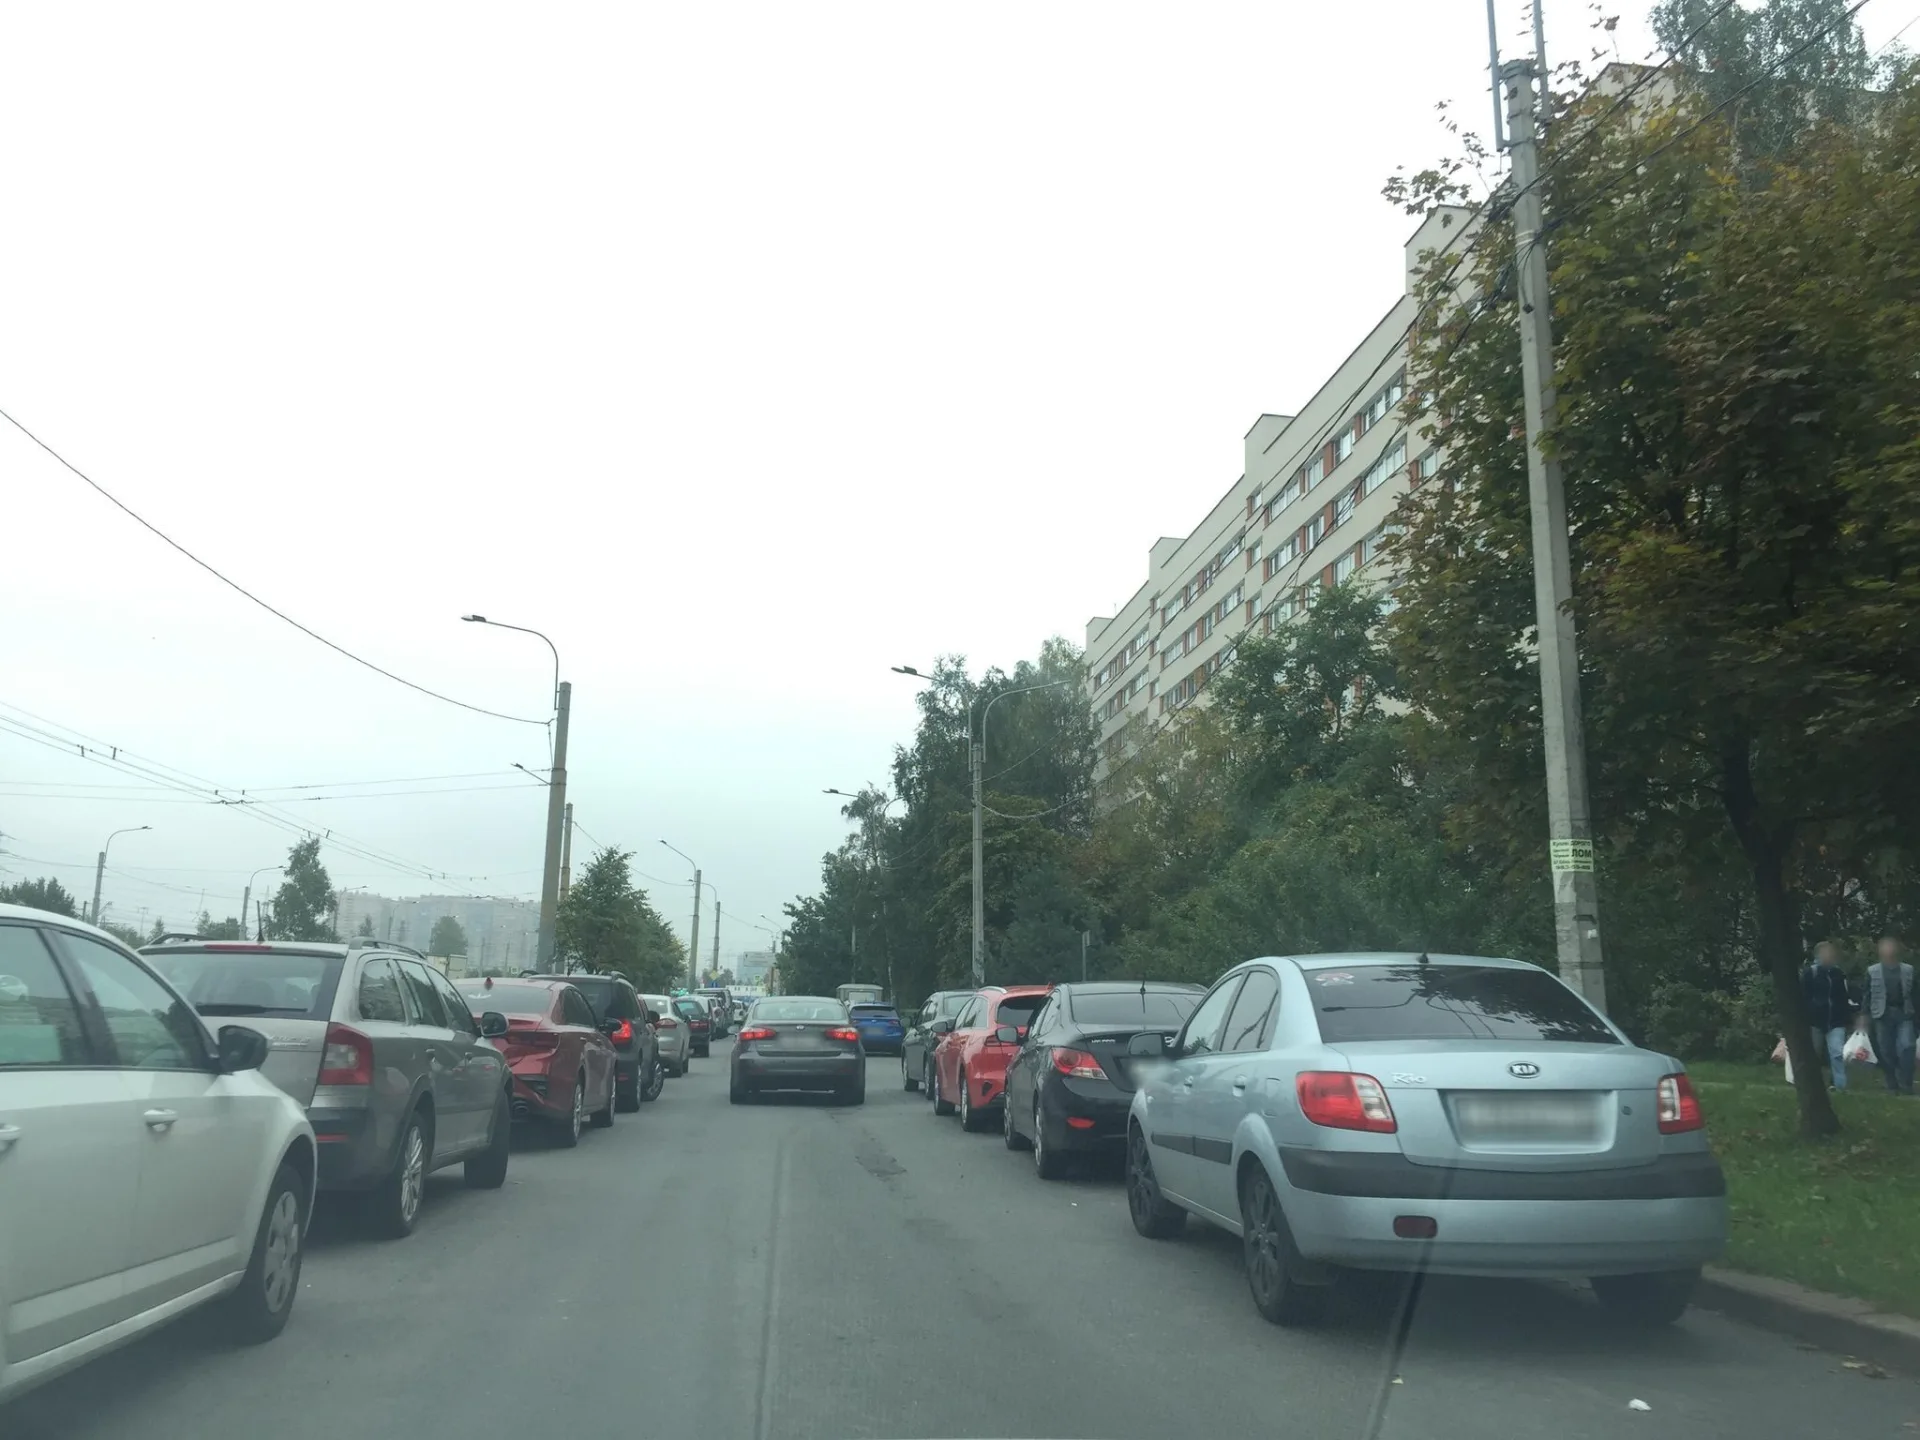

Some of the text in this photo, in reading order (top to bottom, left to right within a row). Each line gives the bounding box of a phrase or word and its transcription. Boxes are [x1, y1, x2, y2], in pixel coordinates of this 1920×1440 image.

[1571, 848, 1591, 858] ЛОМ
[1510, 1063, 1538, 1075] KIA
[1392, 1073, 1426, 1084] Rio
